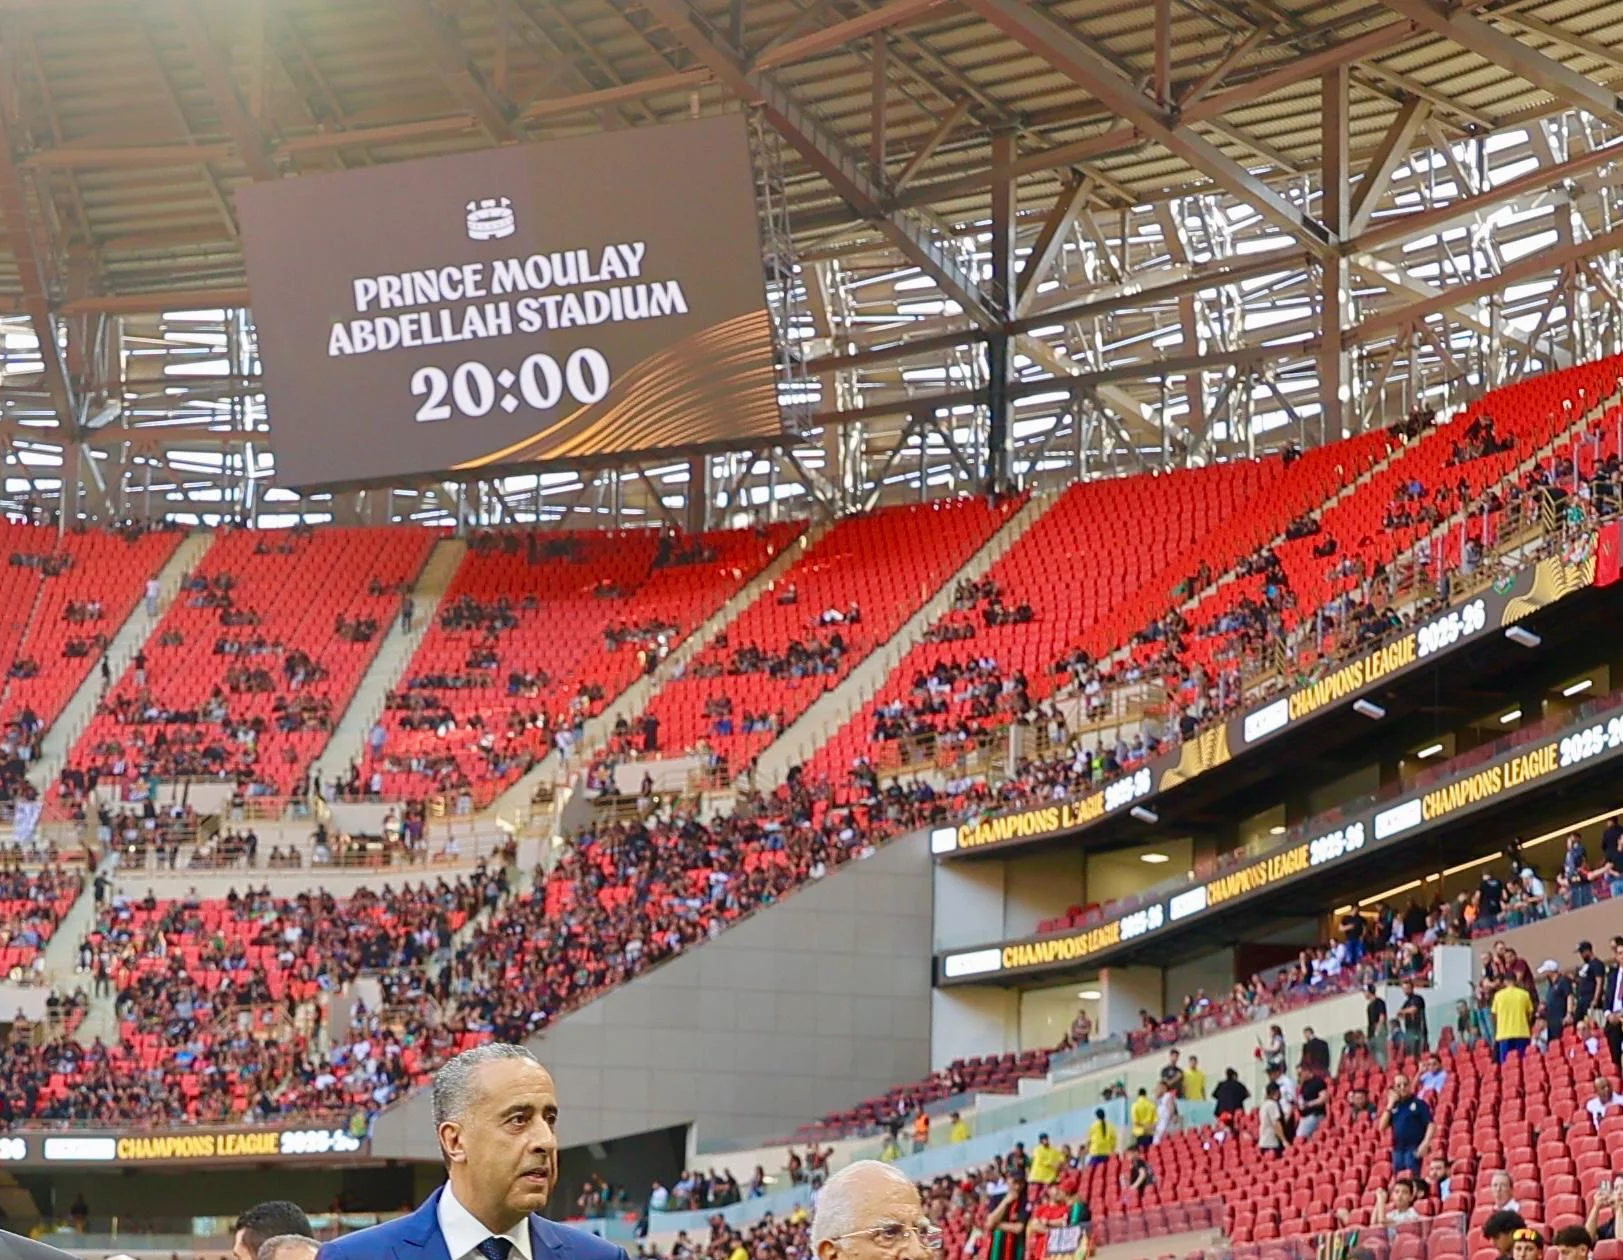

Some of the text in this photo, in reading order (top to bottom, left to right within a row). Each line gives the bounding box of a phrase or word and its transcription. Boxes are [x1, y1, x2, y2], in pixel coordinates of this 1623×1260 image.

[352, 241, 646, 313] PRINCE MOULAY
[327, 280, 689, 357] ABDELLAH STADIUM
[410, 346, 611, 423] 20:00
[1288, 598, 1487, 720] CHAMPIONS LEAGUE 2025-26
[1422, 766, 1502, 820] CHAMPIONS
[1503, 742, 1558, 788] LEAGUE
[1207, 861, 1267, 907] CHAMPIONS
[1267, 844, 1309, 881] LEAGUE
[1002, 934, 1088, 969] CHAMPIONS
[1088, 920, 1120, 953] LEAGUE
[117, 1135, 215, 1160] CHAMPIONS
[216, 1132, 279, 1156] LEAGUE
